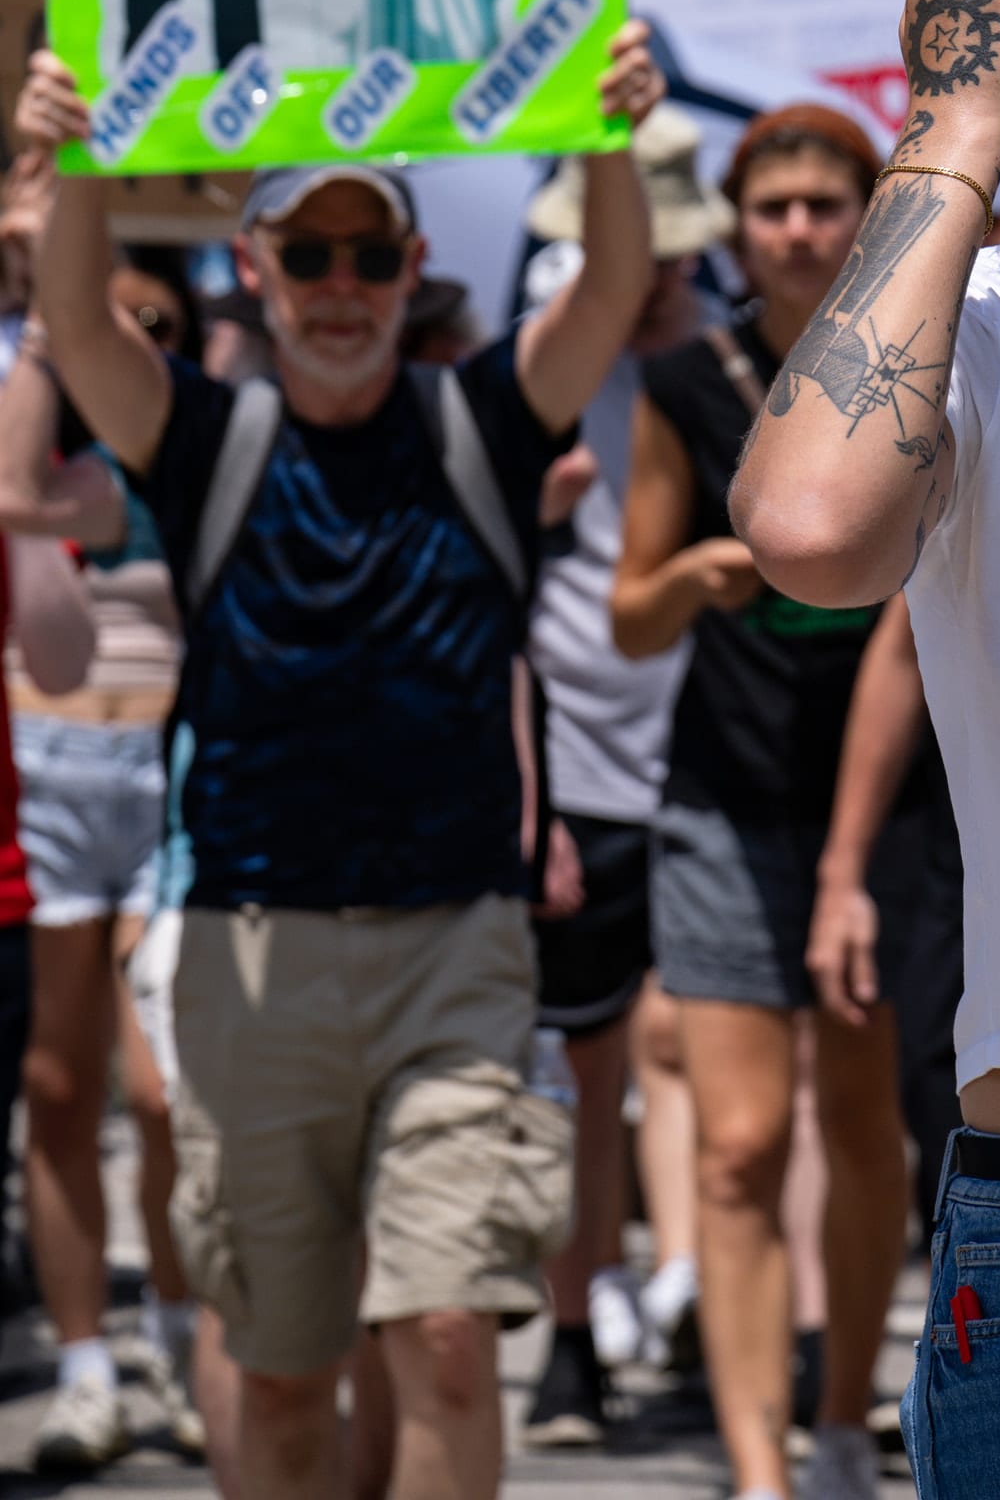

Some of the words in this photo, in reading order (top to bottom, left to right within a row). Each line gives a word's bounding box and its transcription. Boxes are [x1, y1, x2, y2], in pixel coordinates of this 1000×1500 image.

[97, 12, 196, 153] HANDS
[209, 56, 272, 143] OFF
[329, 56, 404, 143] OUR
